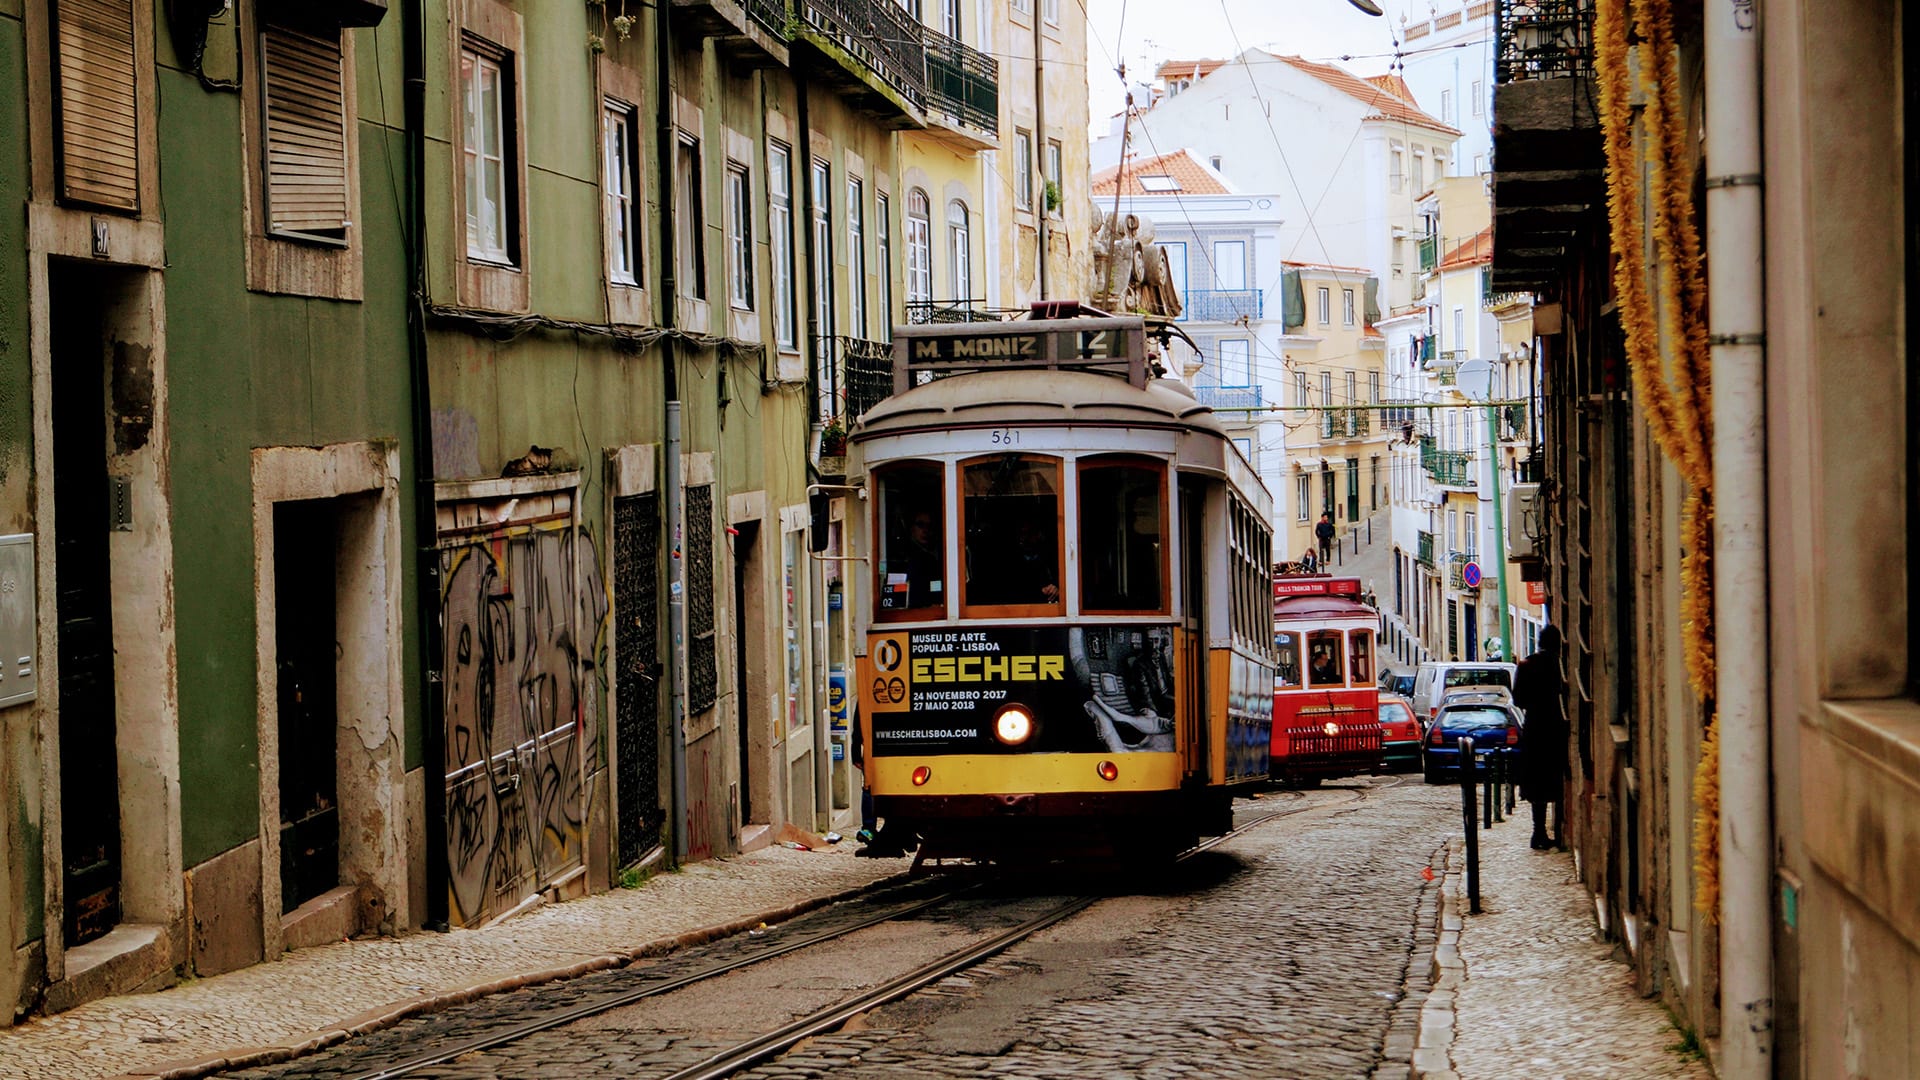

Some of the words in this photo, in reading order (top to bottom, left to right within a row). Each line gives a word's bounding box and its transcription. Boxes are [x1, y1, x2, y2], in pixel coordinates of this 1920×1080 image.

[96, 222, 108, 252] 97
[1076, 331, 1107, 350] 12
[916, 340, 941, 359] M.
[953, 336, 1037, 358] MONIZ
[992, 430, 1020, 444] 561
[882, 598, 893, 607] 02
[912, 634, 943, 643] MUSEU
[945, 633, 958, 642] DE
[960, 632, 987, 642] ARTE
[912, 643, 954, 653] POPULAR
[962, 642, 1001, 652] LISBOA
[912, 655, 1065, 683] ESCHER
[913, 692, 924, 701] 24
[926, 690, 980, 700] NOVEMBRO
[983, 690, 1007, 699] 2017
[913, 702, 924, 711] 27
[925, 702, 949, 710] MAIO
[951, 701, 975, 710] 2018
[875, 729, 977, 739] WWW.ESCHERLISBOA.COM
